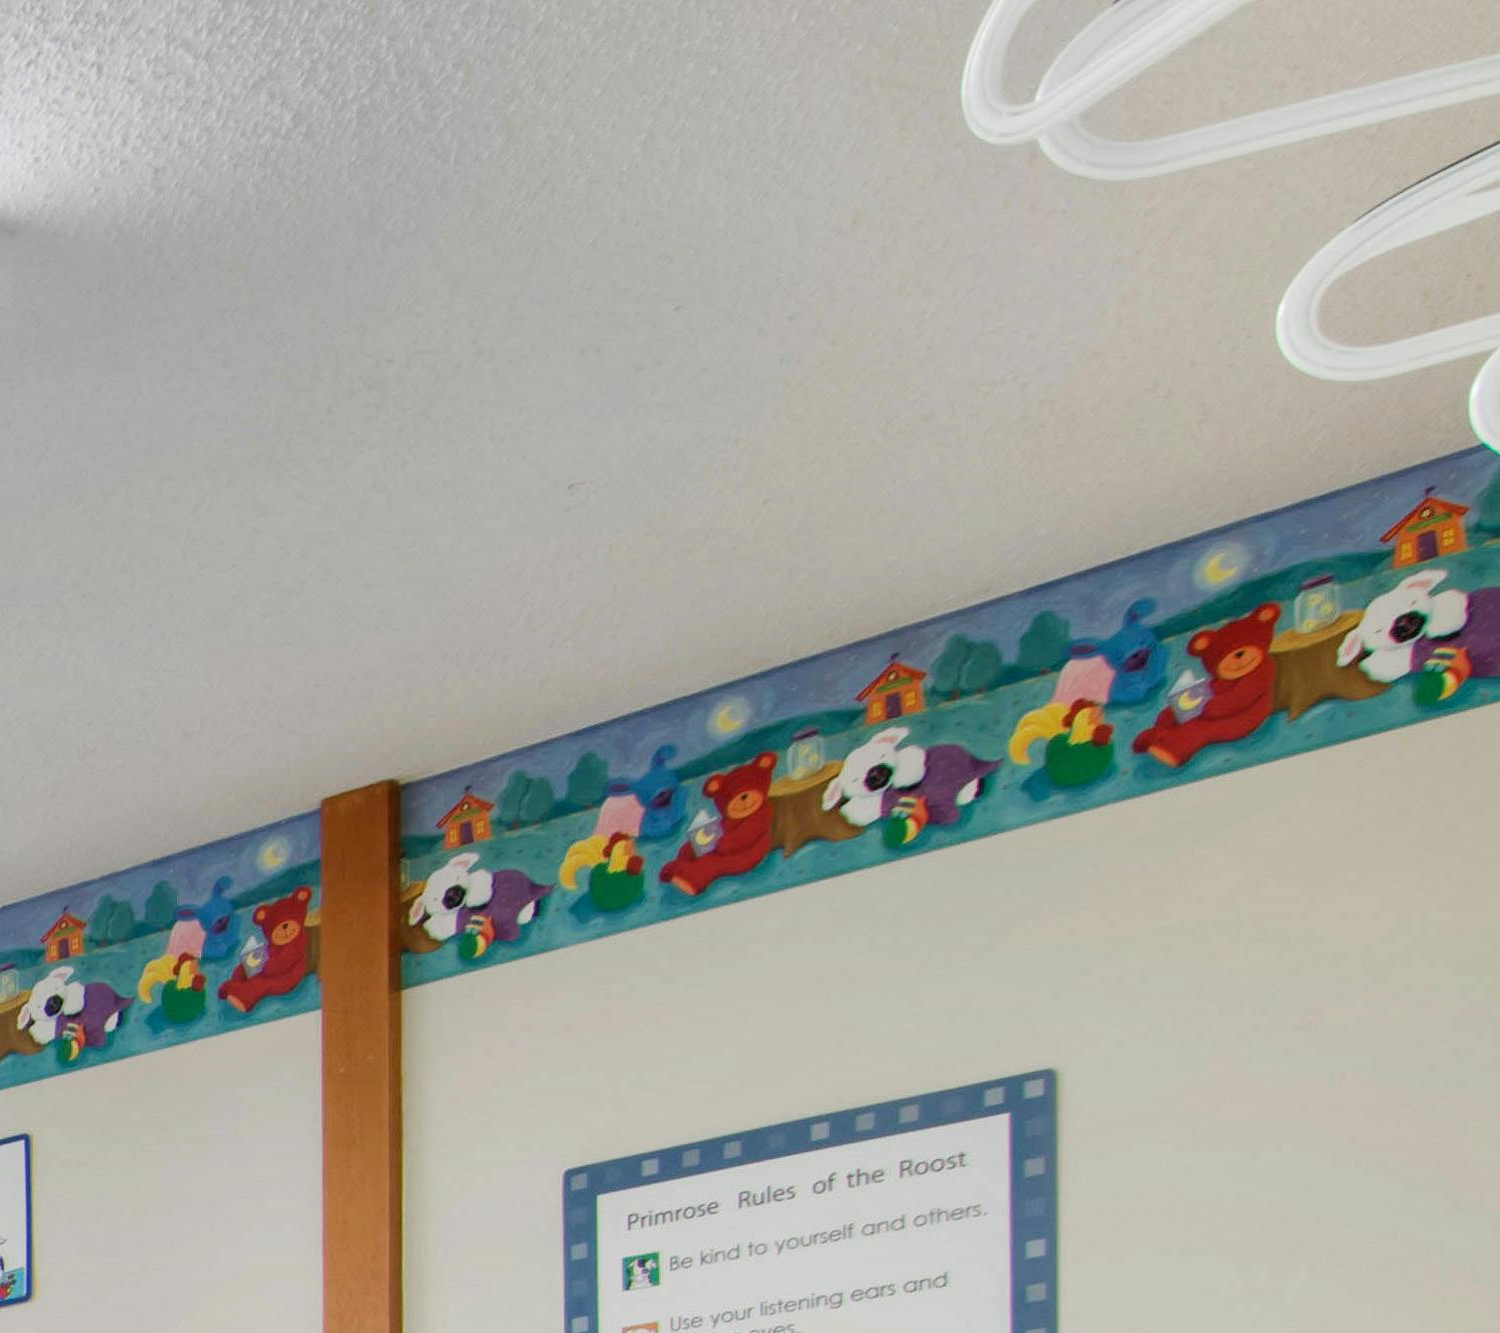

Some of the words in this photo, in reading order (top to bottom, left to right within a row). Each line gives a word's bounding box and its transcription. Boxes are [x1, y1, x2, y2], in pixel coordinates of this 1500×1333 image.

[626, 1201, 719, 1231] Primrose
[737, 1185, 796, 1209] Rules
[812, 1172, 837, 1195] of
[846, 1168, 885, 1188] the
[899, 1151, 968, 1179] Roost
[669, 1255, 693, 1271] Be
[699, 1243, 741, 1266] kind
[747, 1241, 768, 1256] to
[775, 1222, 854, 1255] yourself
[861, 1214, 906, 1236] and
[913, 1203, 988, 1227] others.
[669, 1316, 703, 1332] Use
[710, 1305, 754, 1328] your
[759, 1291, 843, 1316] listening
[850, 1282, 896, 1301] ears
[903, 1272, 949, 1293] and
